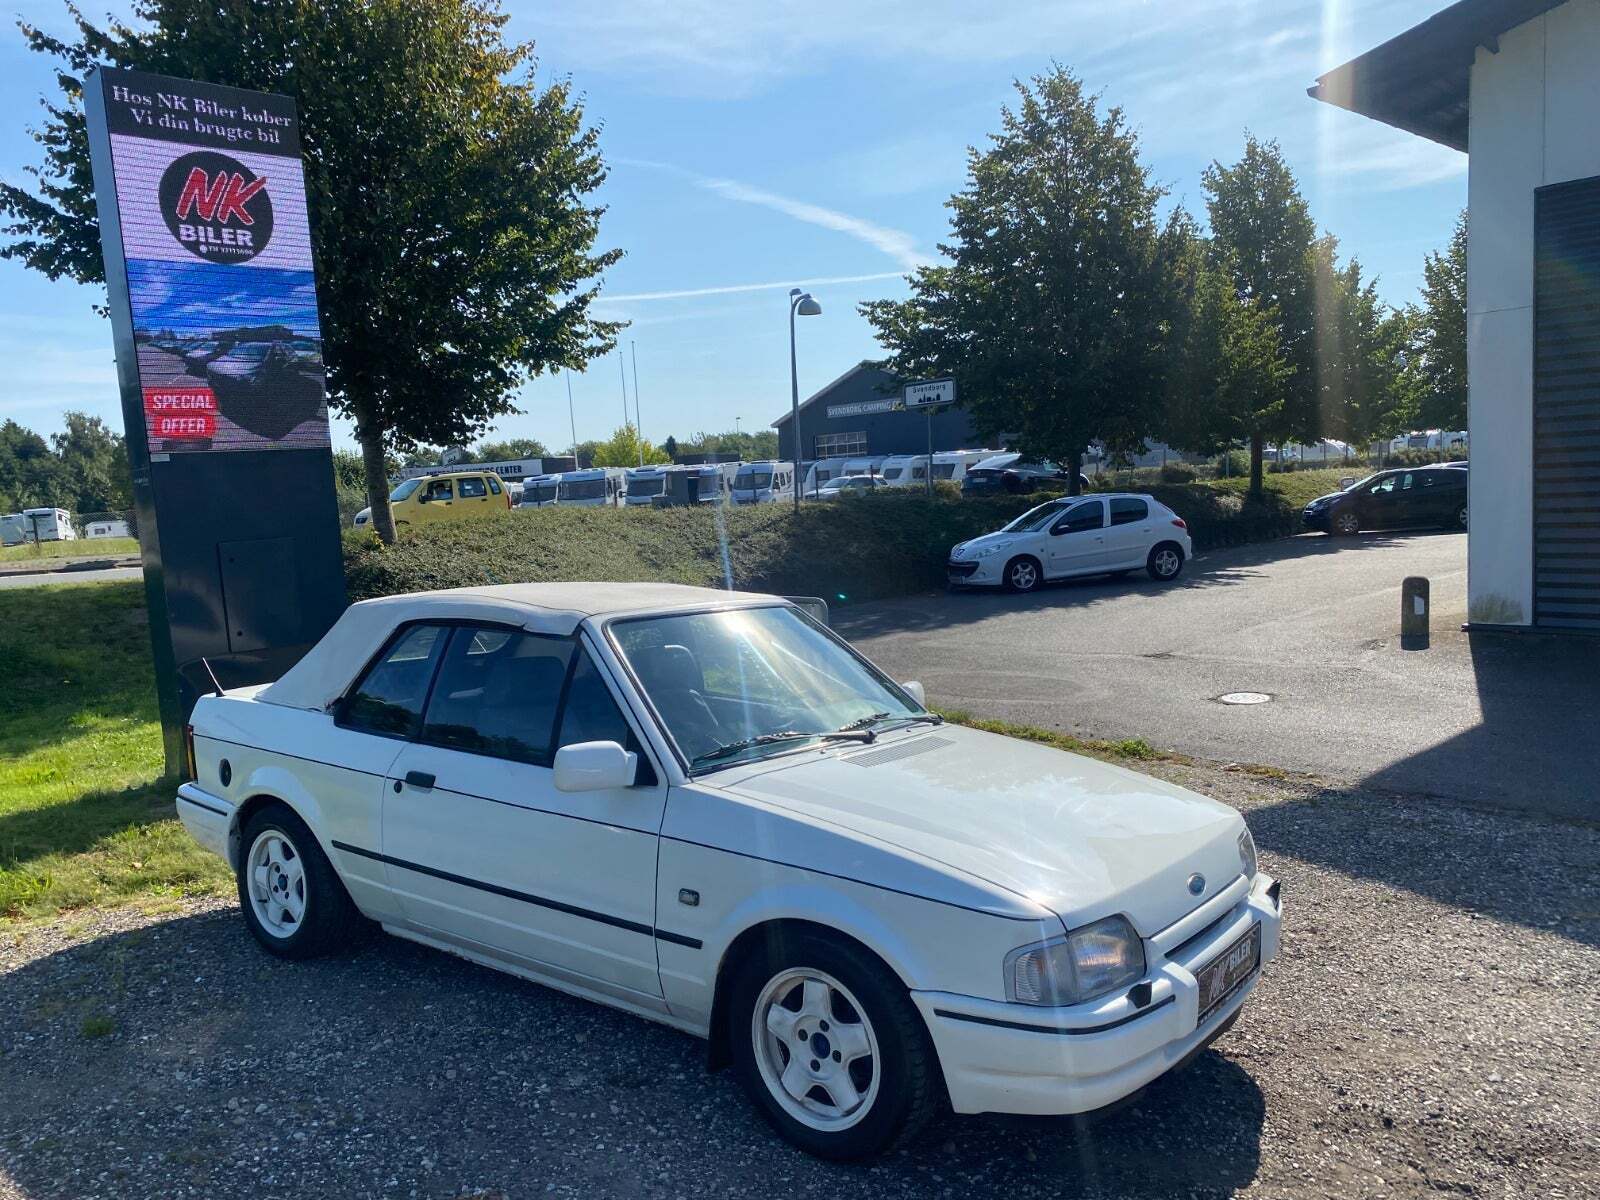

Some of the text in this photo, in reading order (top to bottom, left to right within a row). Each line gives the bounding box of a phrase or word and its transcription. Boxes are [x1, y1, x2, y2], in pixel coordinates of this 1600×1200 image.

[112, 85, 152, 106] Hos
[156, 92, 189, 111] NK
[193, 98, 237, 119] Biler
[130, 107, 280, 144] Vi din brugte bil
[176, 166, 268, 225] NK
[179, 224, 254, 247] BILER
[152, 394, 213, 409] SPECIAL
[863, 401, 892, 413] CAMPING
[161, 418, 206, 433] OFFER
[495, 465, 522, 475] CENTER
